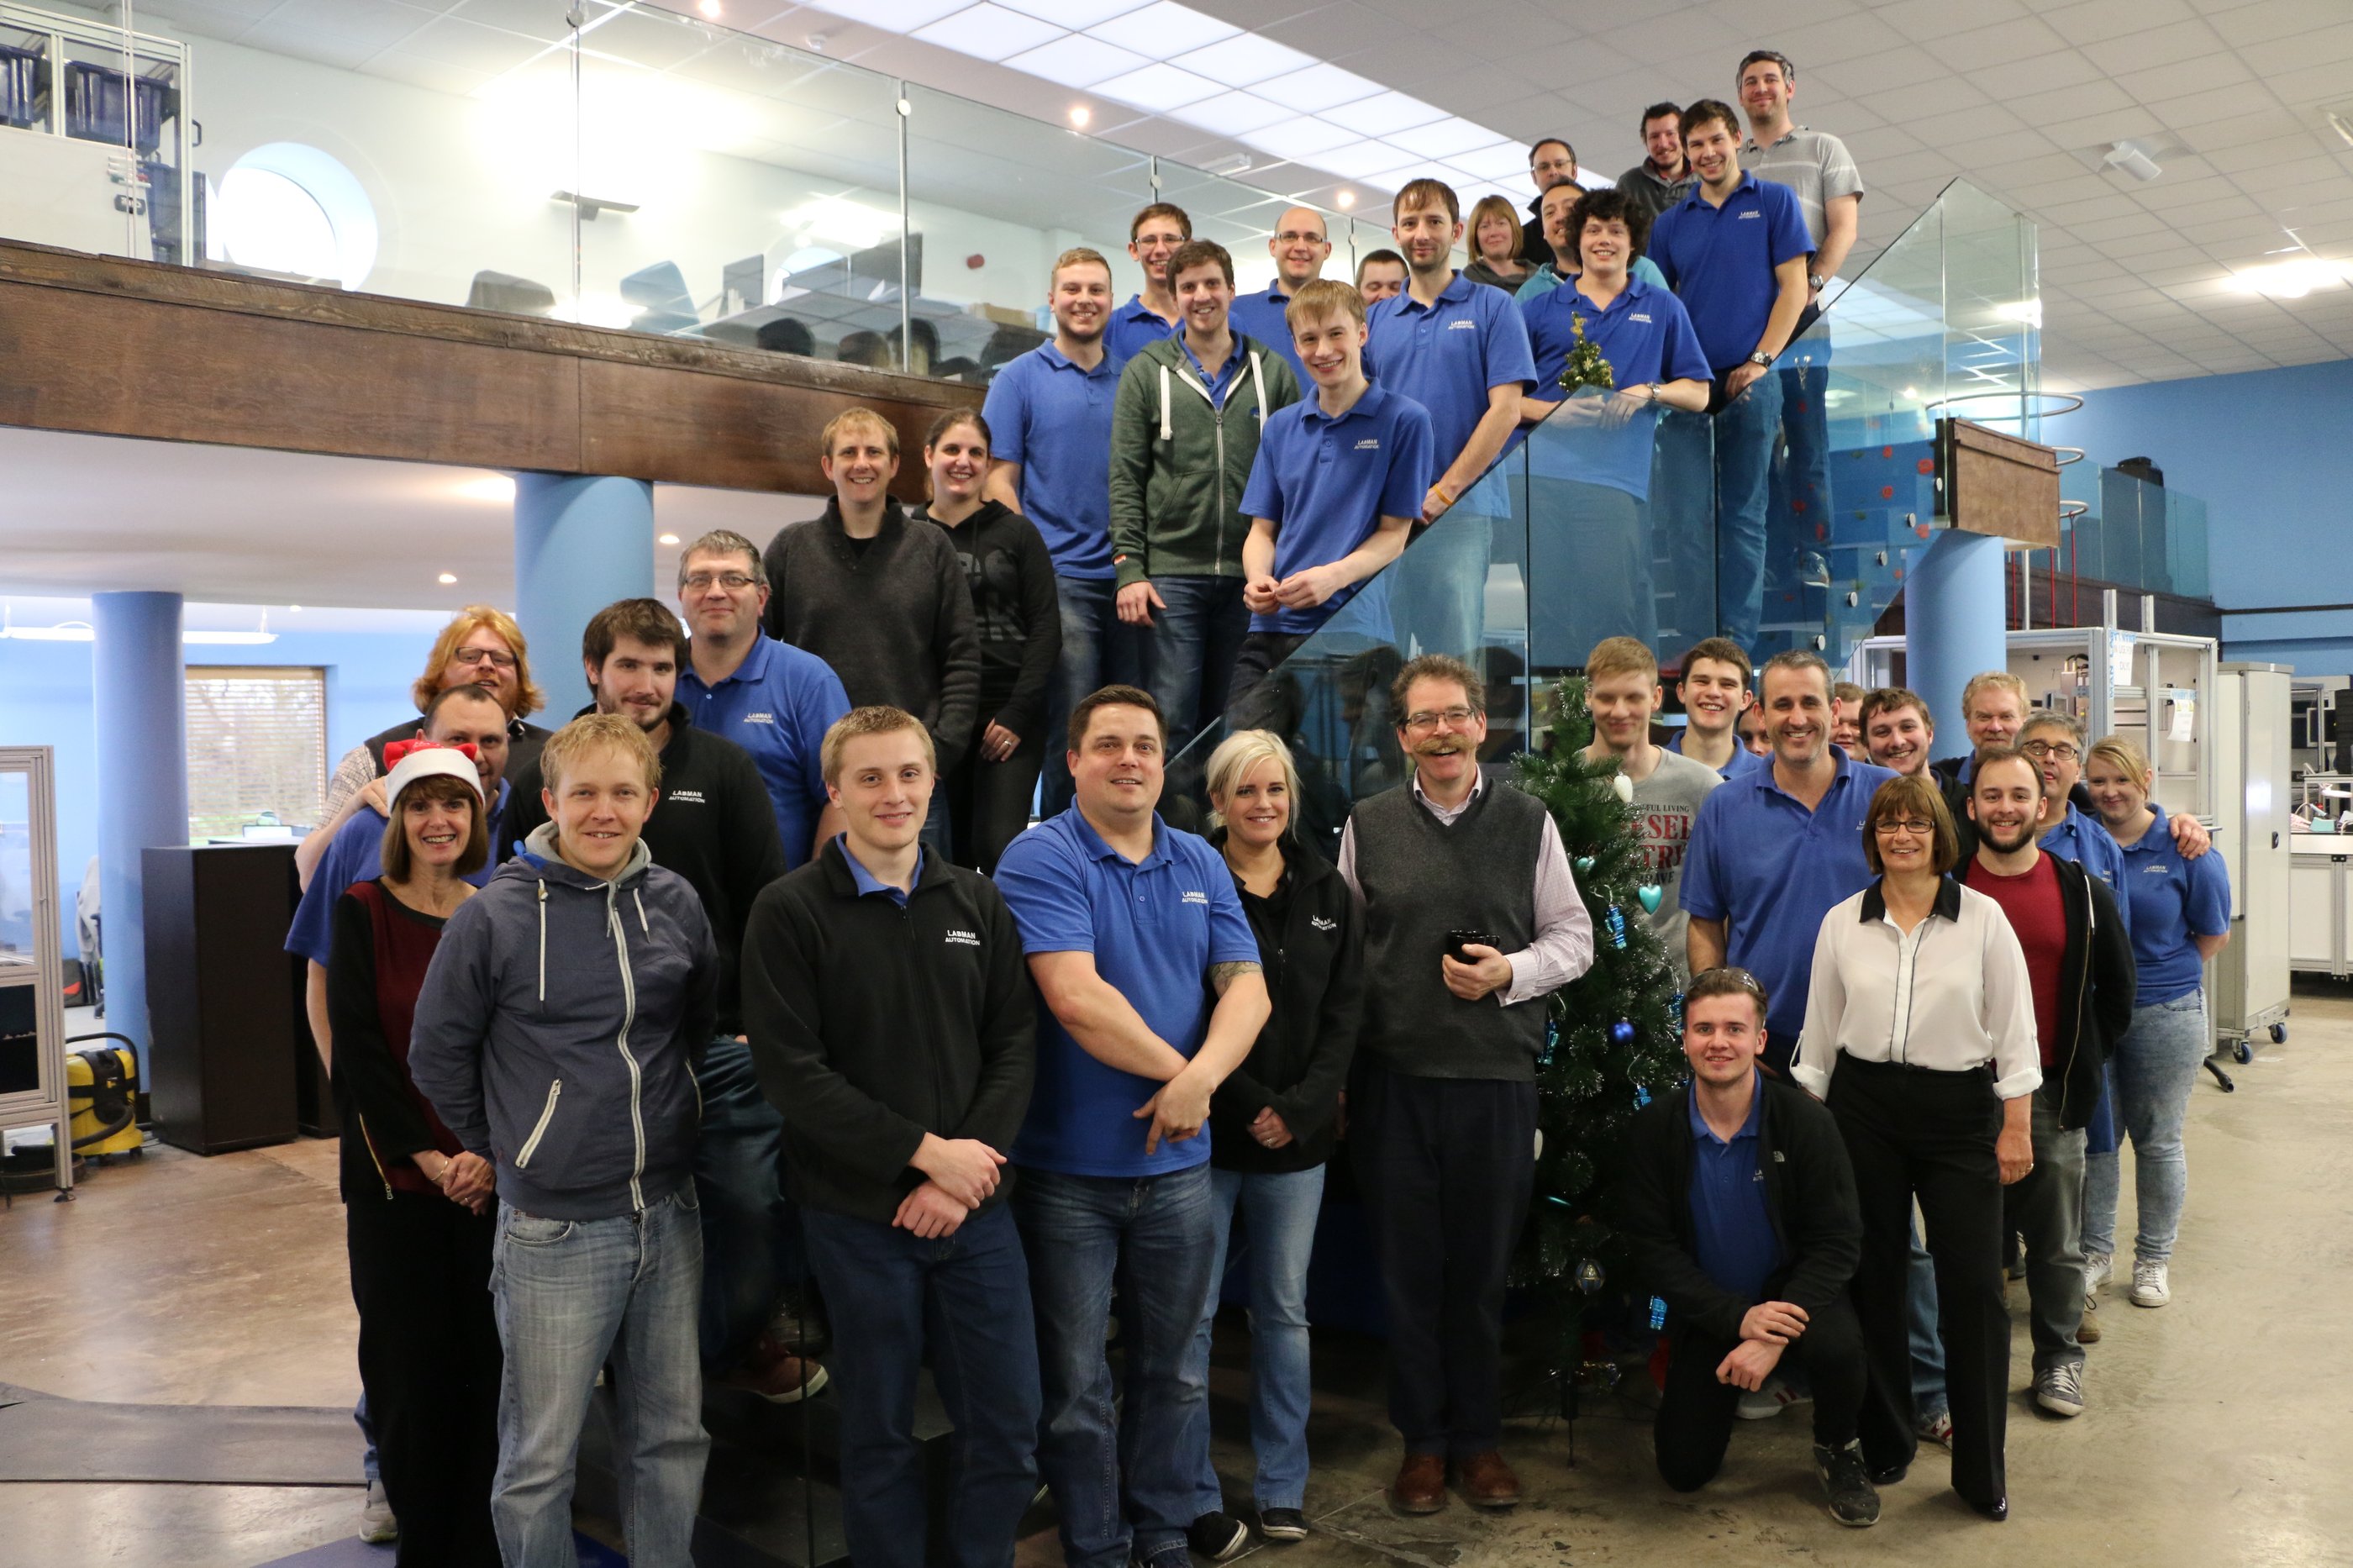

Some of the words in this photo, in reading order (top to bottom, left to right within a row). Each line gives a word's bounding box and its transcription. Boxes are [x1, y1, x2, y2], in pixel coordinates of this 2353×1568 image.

[1663, 804, 1689, 813] LIVING
[947, 929, 976, 939] LABMAN
[945, 937, 981, 946] AUTOMATION
